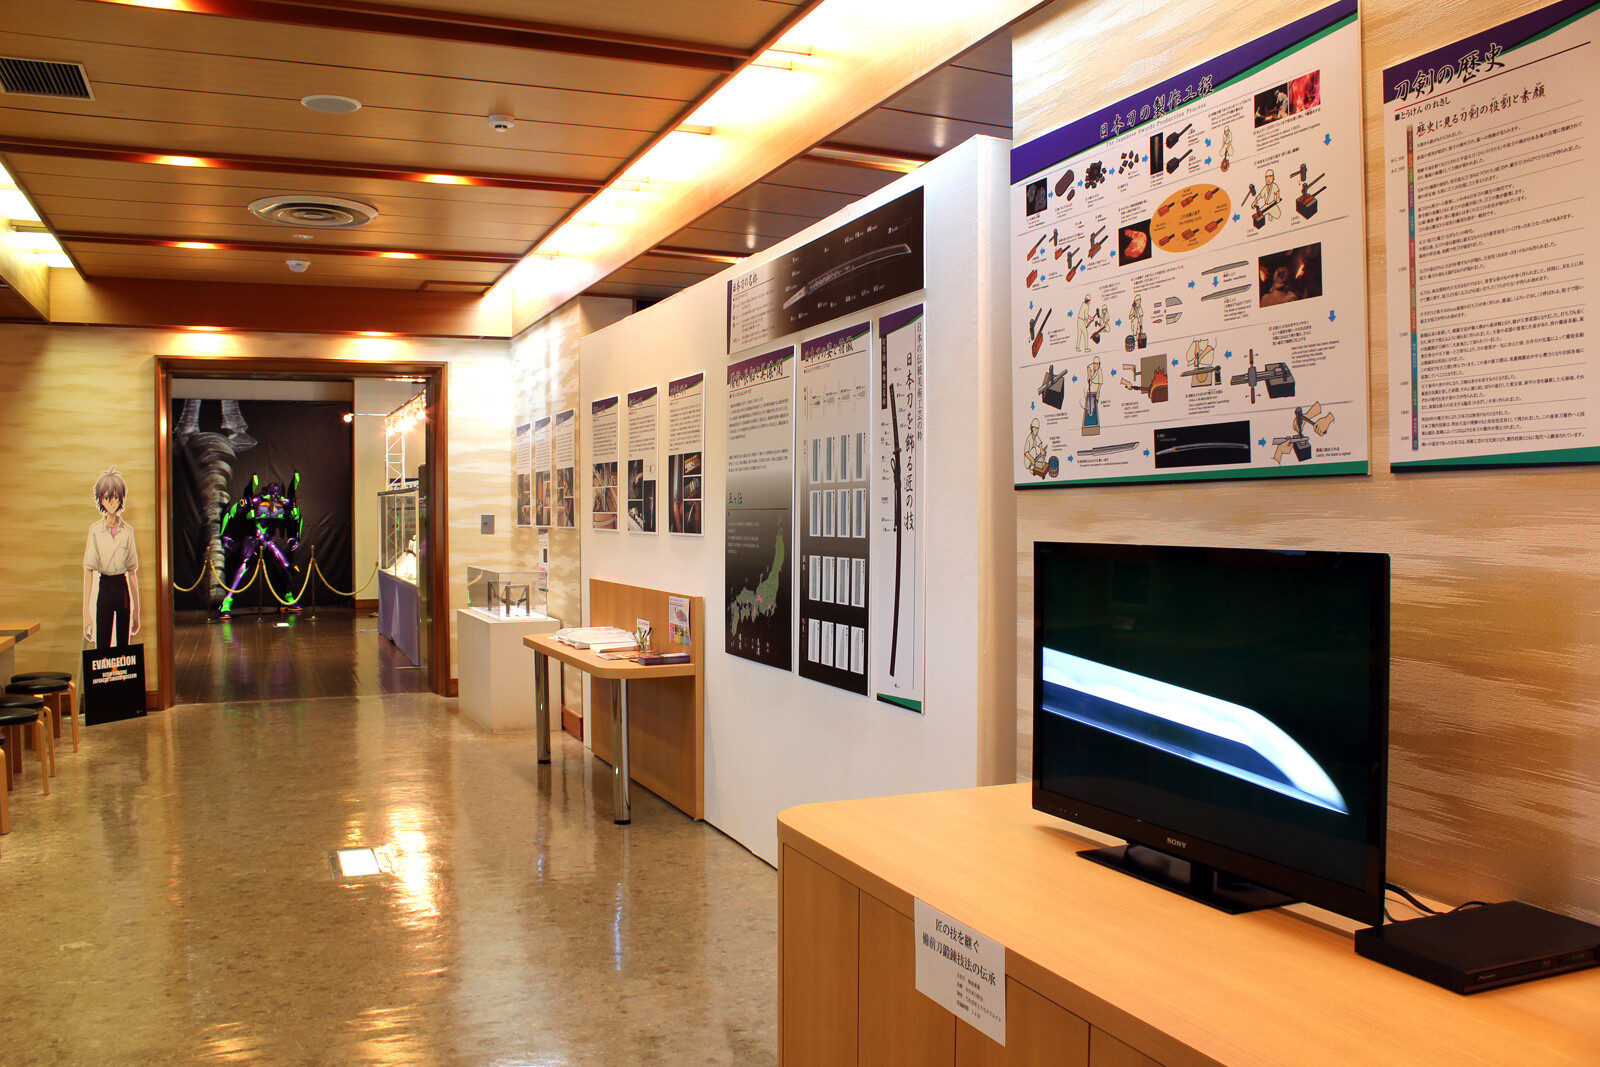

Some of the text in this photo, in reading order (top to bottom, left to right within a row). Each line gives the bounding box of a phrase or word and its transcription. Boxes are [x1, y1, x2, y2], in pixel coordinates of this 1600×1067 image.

[1394, 43, 1506, 102] 刀剣の歴史
[1100, 74, 1214, 138] 日本刀の製作工程
[1116, 132, 1136, 146] Japanese
[1138, 124, 1155, 134] Swords
[1156, 111, 1184, 128] Production
[1186, 102, 1206, 115] Process
[1416, 83, 1546, 138] 歴史に見る刀剣の役割と素顔
[905, 352, 914, 531] 日本刀を飾る匠の技
[92, 655, 136, 670] EVANGELION
[1167, 838, 1186, 848] SONY
[922, 932, 996, 986] 備前刀鍛錬技法の伝承
[935, 919, 980, 954] 匠の技を継ぐ
